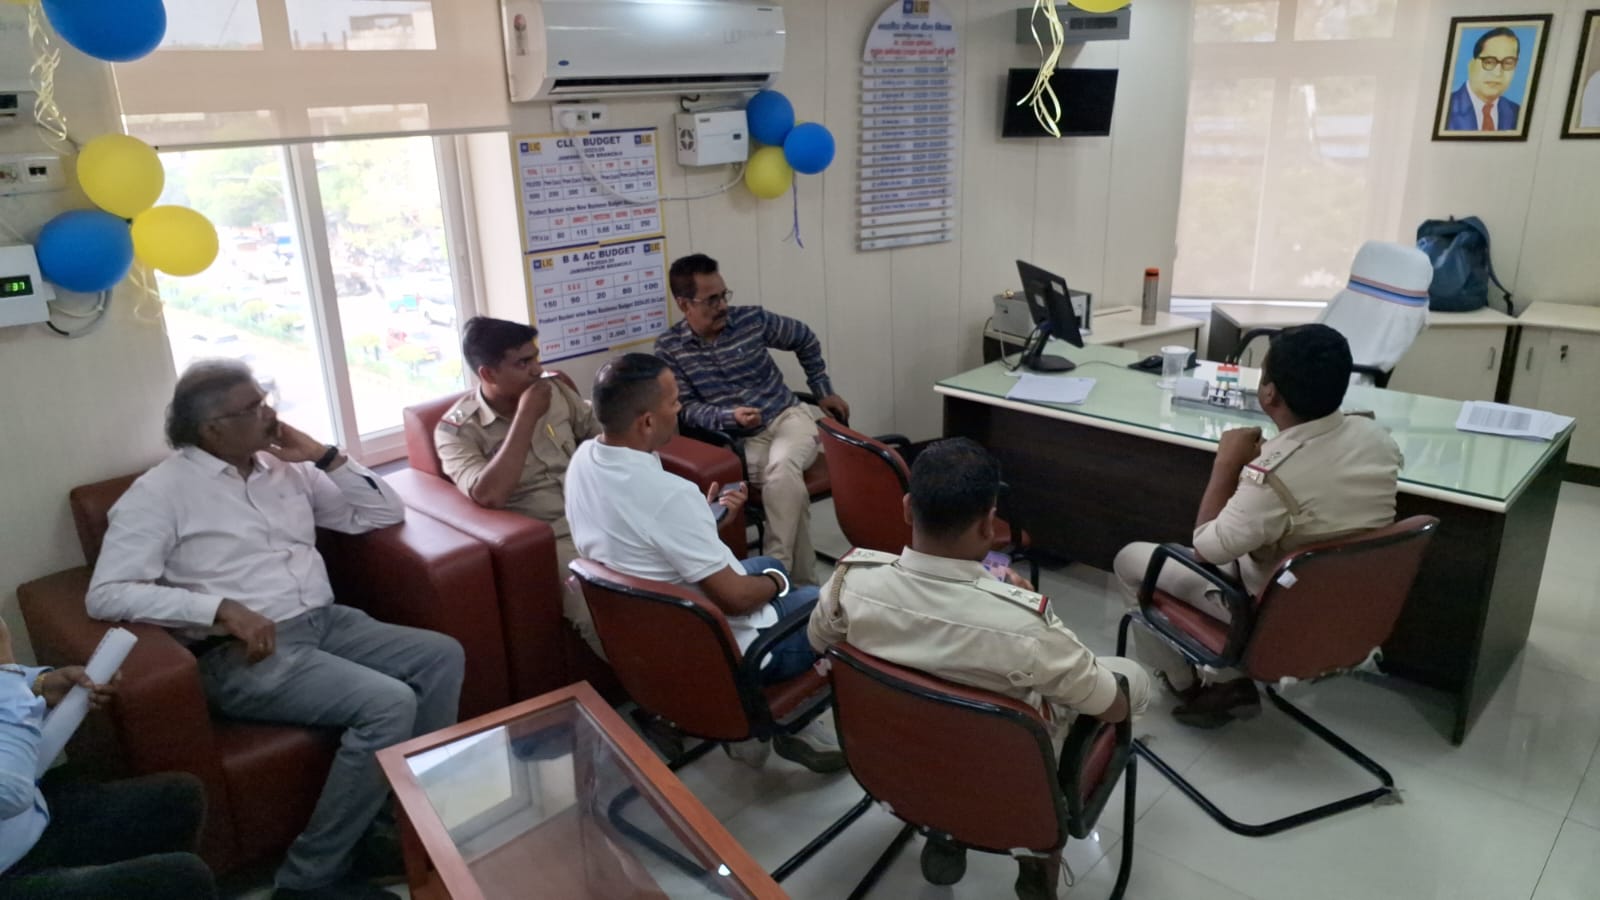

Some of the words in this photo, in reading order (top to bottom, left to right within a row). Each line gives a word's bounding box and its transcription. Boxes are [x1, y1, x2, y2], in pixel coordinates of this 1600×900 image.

[583, 135, 621, 146] BUDGET
[562, 255, 569, 263] B
[573, 254, 580, 262] &
[583, 251, 596, 260] AC
[598, 246, 636, 258] BUDGET
